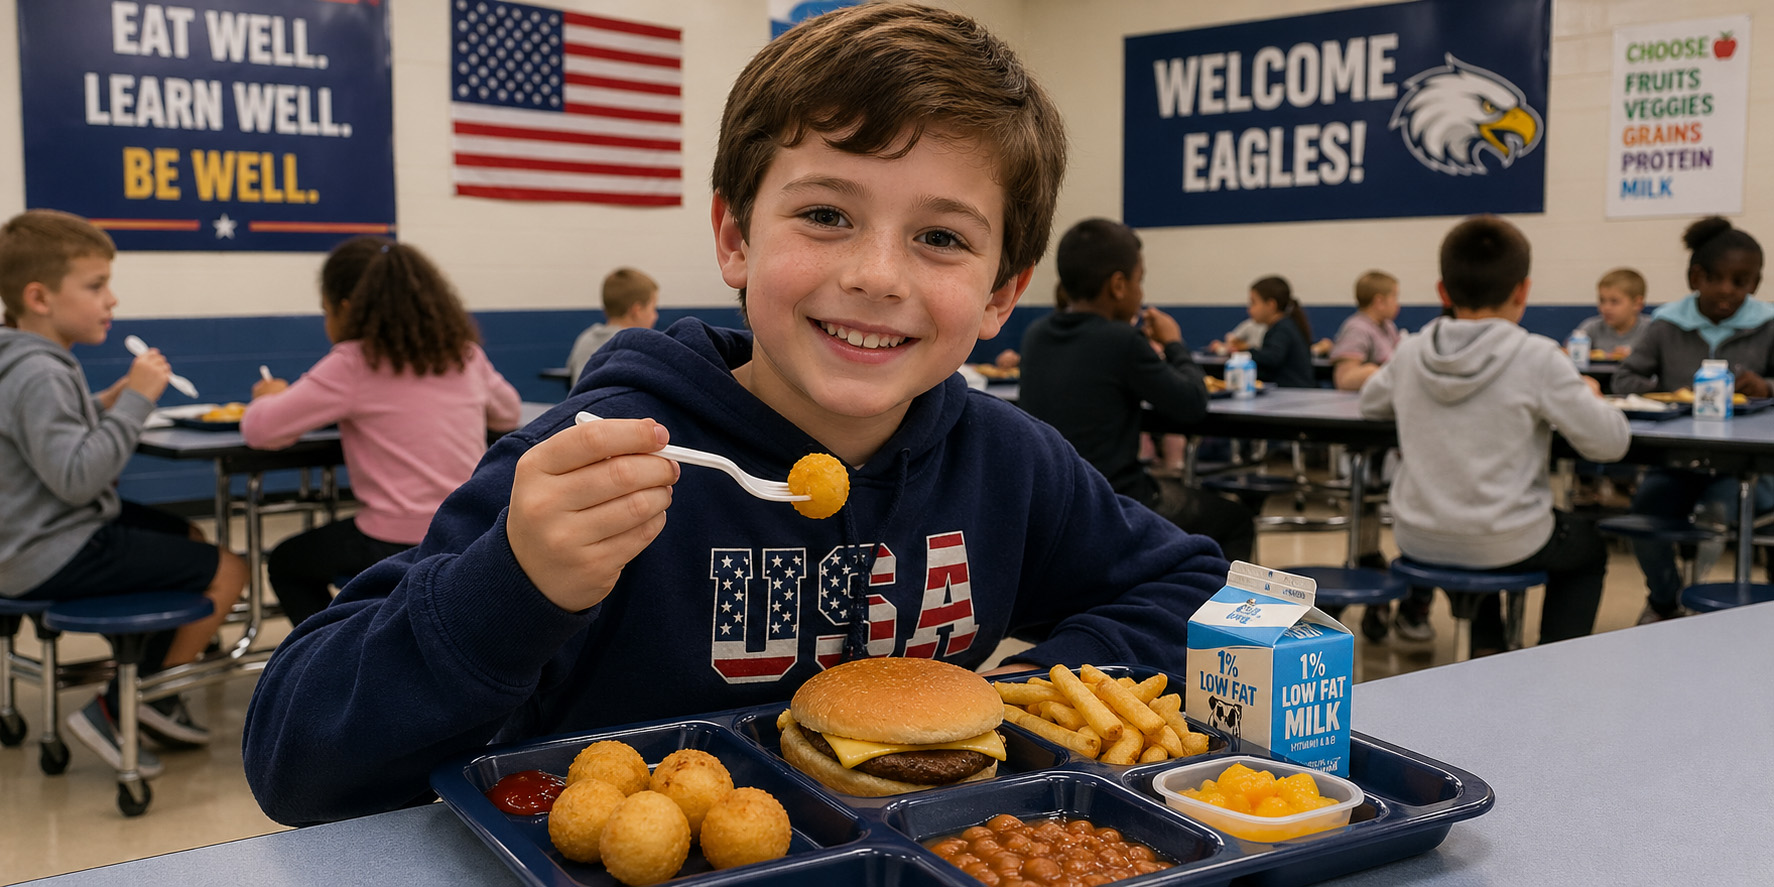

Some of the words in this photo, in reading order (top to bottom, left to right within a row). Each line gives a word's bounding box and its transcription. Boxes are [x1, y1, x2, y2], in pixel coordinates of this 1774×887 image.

[111, 1, 195, 59] EAT
[205, 10, 328, 69] WELL.
[1626, 36, 1709, 63] CHOOSE
[1153, 33, 1399, 118] WELCOME
[1625, 68, 1700, 94] FRUITS
[84, 72, 223, 131] LEARN
[233, 81, 352, 137] WELL.
[1624, 93, 1714, 119] VEGGIES
[1622, 122, 1702, 147] GRAINS
[1182, 120, 1367, 192] EAGLES!
[1621, 148, 1713, 172] PROTEIN
[123, 147, 181, 200] BE
[191, 149, 319, 203] WELL.
[1620, 177, 1673, 199] MILK
[709, 530, 980, 684] USA
[1217, 650, 1238, 677] 1%
[1300, 651, 1326, 680] 1%
[1200, 671, 1228, 697] LOW
[1231, 680, 1257, 706] FAT
[1282, 680, 1316, 707] LOW
[1320, 676, 1346, 700] FAT
[1285, 701, 1341, 740] MILK
